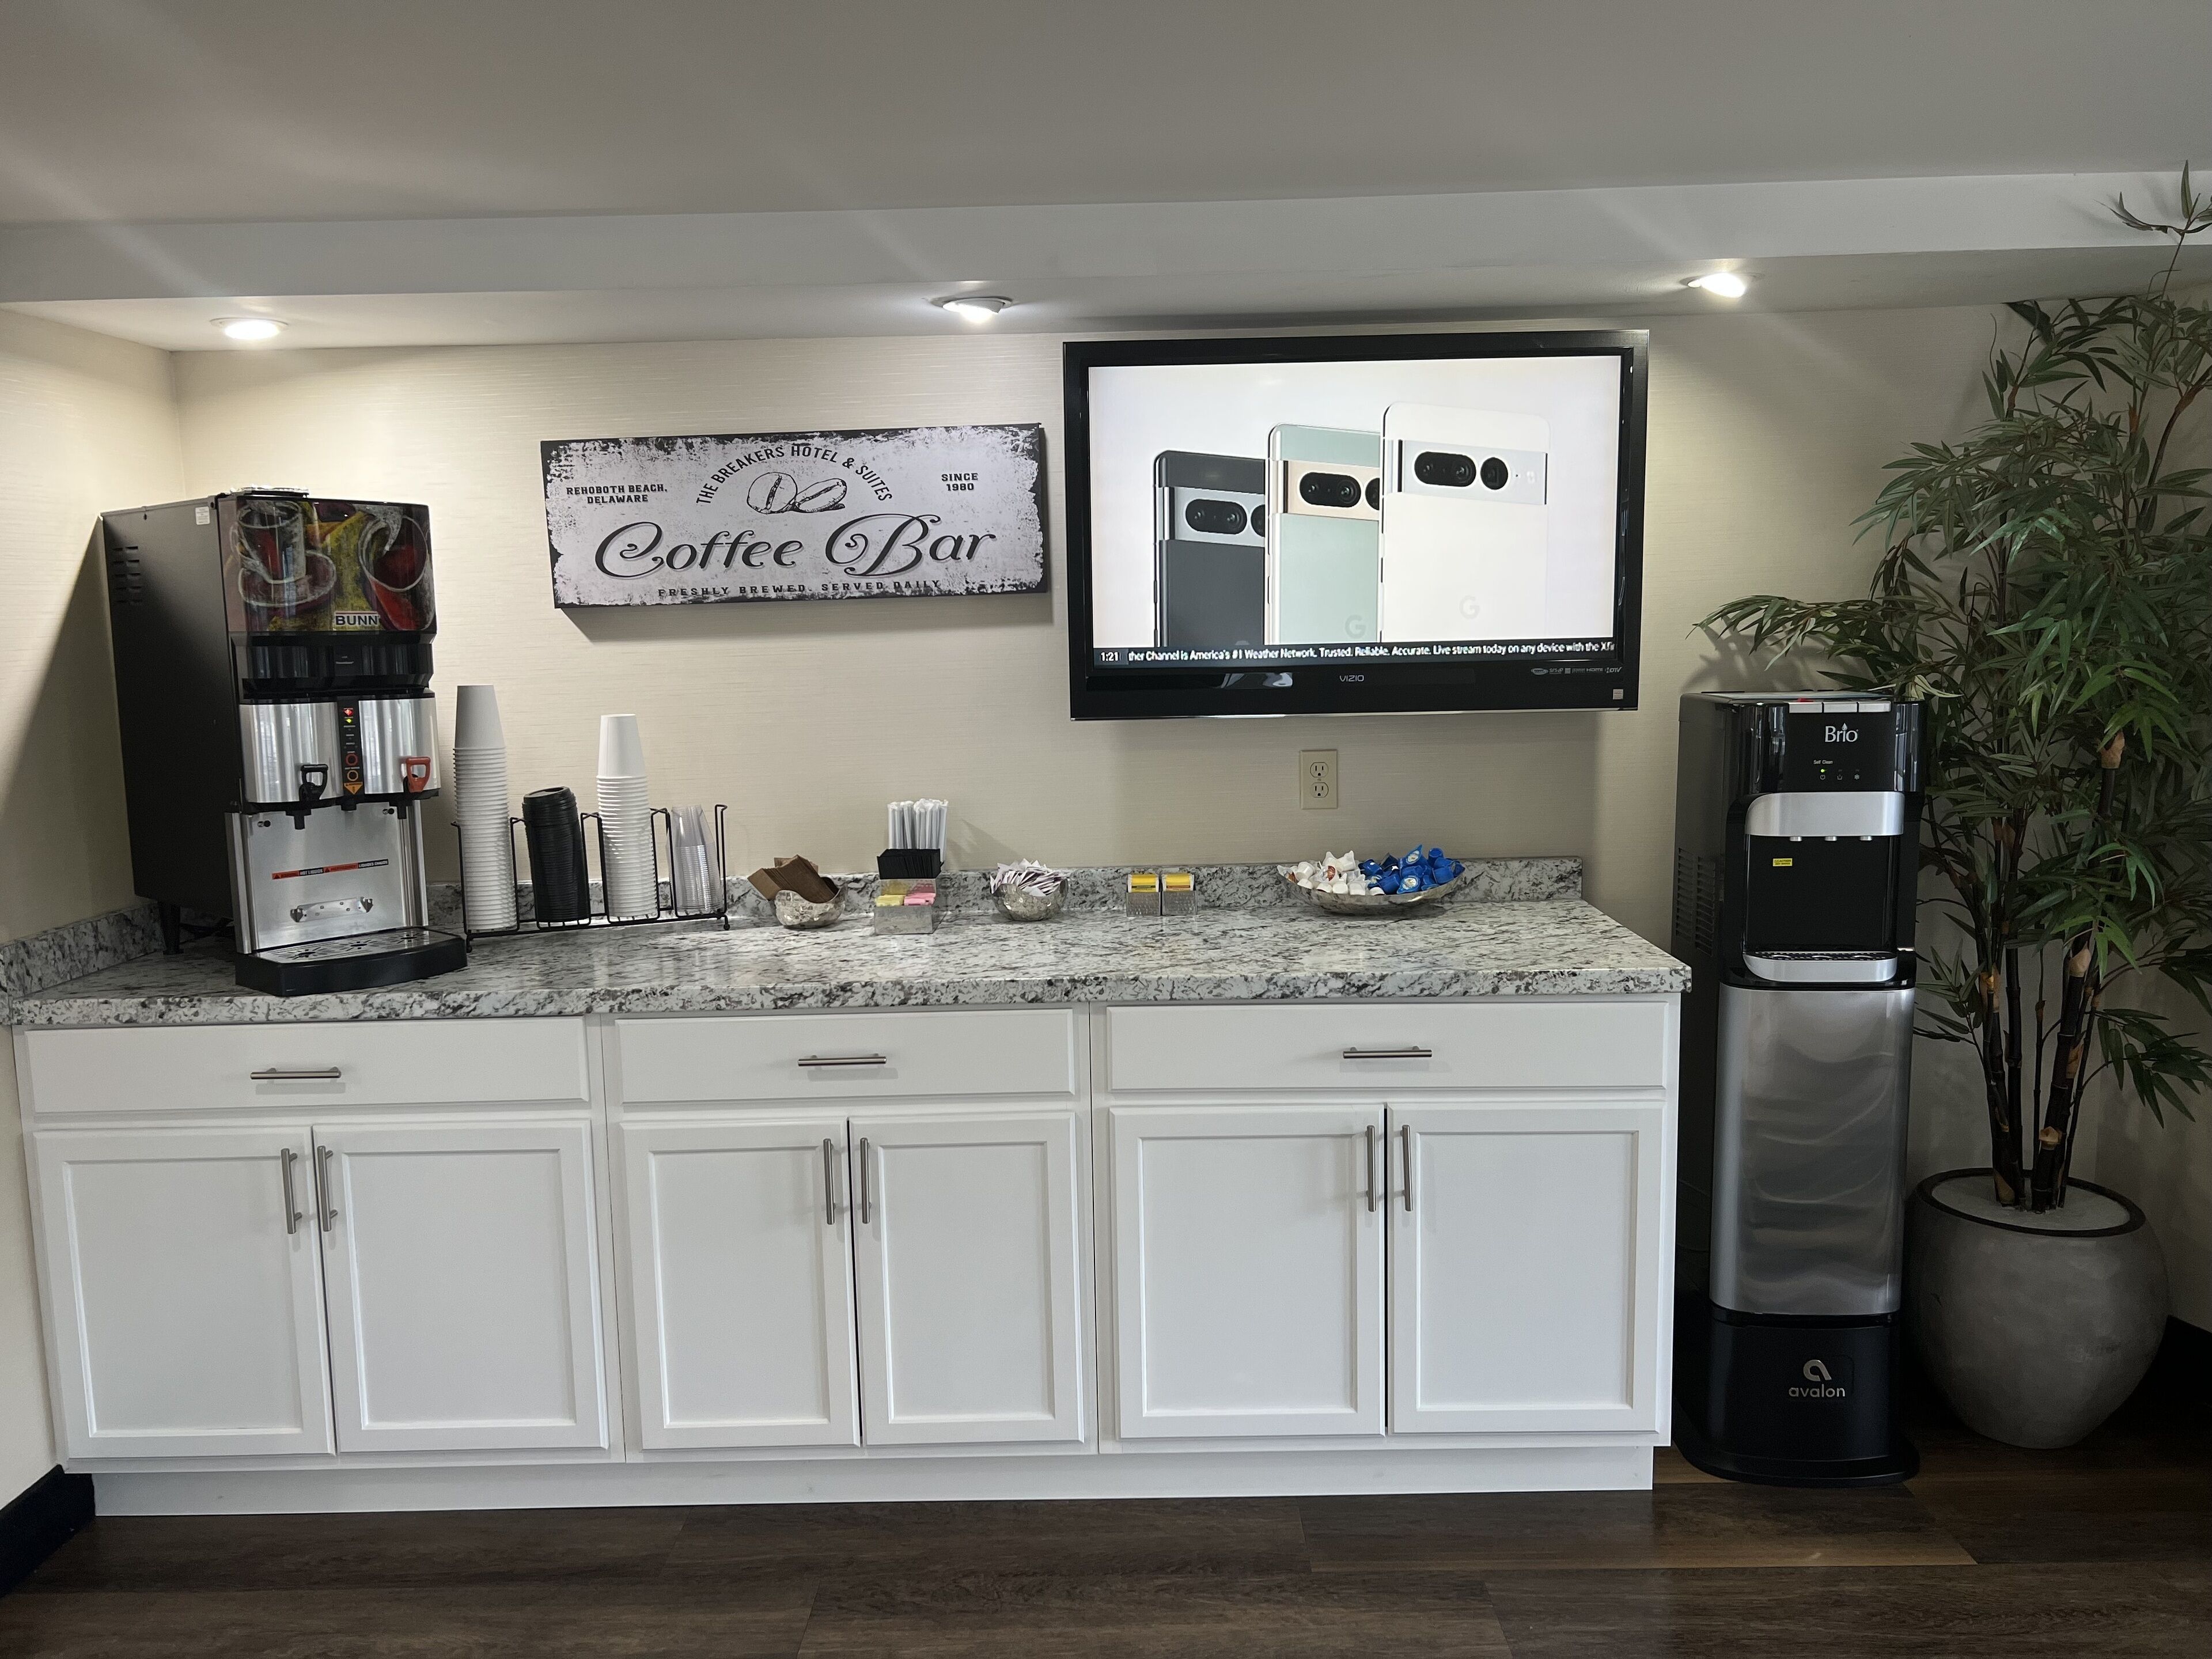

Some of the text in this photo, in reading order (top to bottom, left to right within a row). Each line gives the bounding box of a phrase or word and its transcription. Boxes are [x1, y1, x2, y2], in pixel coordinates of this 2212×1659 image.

[696, 445, 892, 504] THE BREAKERS HOTEL & SUITES
[941, 473, 978, 482] SINCE
[566, 484, 668, 495] REHOBOTH BEACH,
[946, 483, 974, 491] 1980
[587, 494, 649, 504] DELAWARE
[594, 513, 997, 578] Coffee Bar
[658, 586, 729, 597] FRESHLY
[821, 582, 884, 591] SERVED
[893, 579, 940, 589] DAILY
[335, 615, 378, 626] BUNN
[1100, 652, 1119, 661] 1:21
[1146, 650, 1179, 661] Channel
[1180, 650, 1188, 660] is
[1190, 650, 1230, 660] America's
[1244, 649, 1279, 659] Weather
[1280, 647, 1317, 658] Network.
[1319, 647, 1354, 658] Trusted.
[1355, 646, 1390, 657] Reliable.
[1391, 645, 1432, 656] Accurate.
[1433, 645, 1450, 655] Live
[1452, 645, 1481, 654] stream
[1483, 643, 1506, 656] today
[1508, 645, 1519, 654] on
[1520, 643, 1536, 654] any
[1537, 642, 1565, 653] device
[1566, 641, 1584, 652] with
[1585, 641, 1600, 652] the
[1824, 722, 1858, 743] Brio
[1788, 1383, 1846, 1397] avalon
